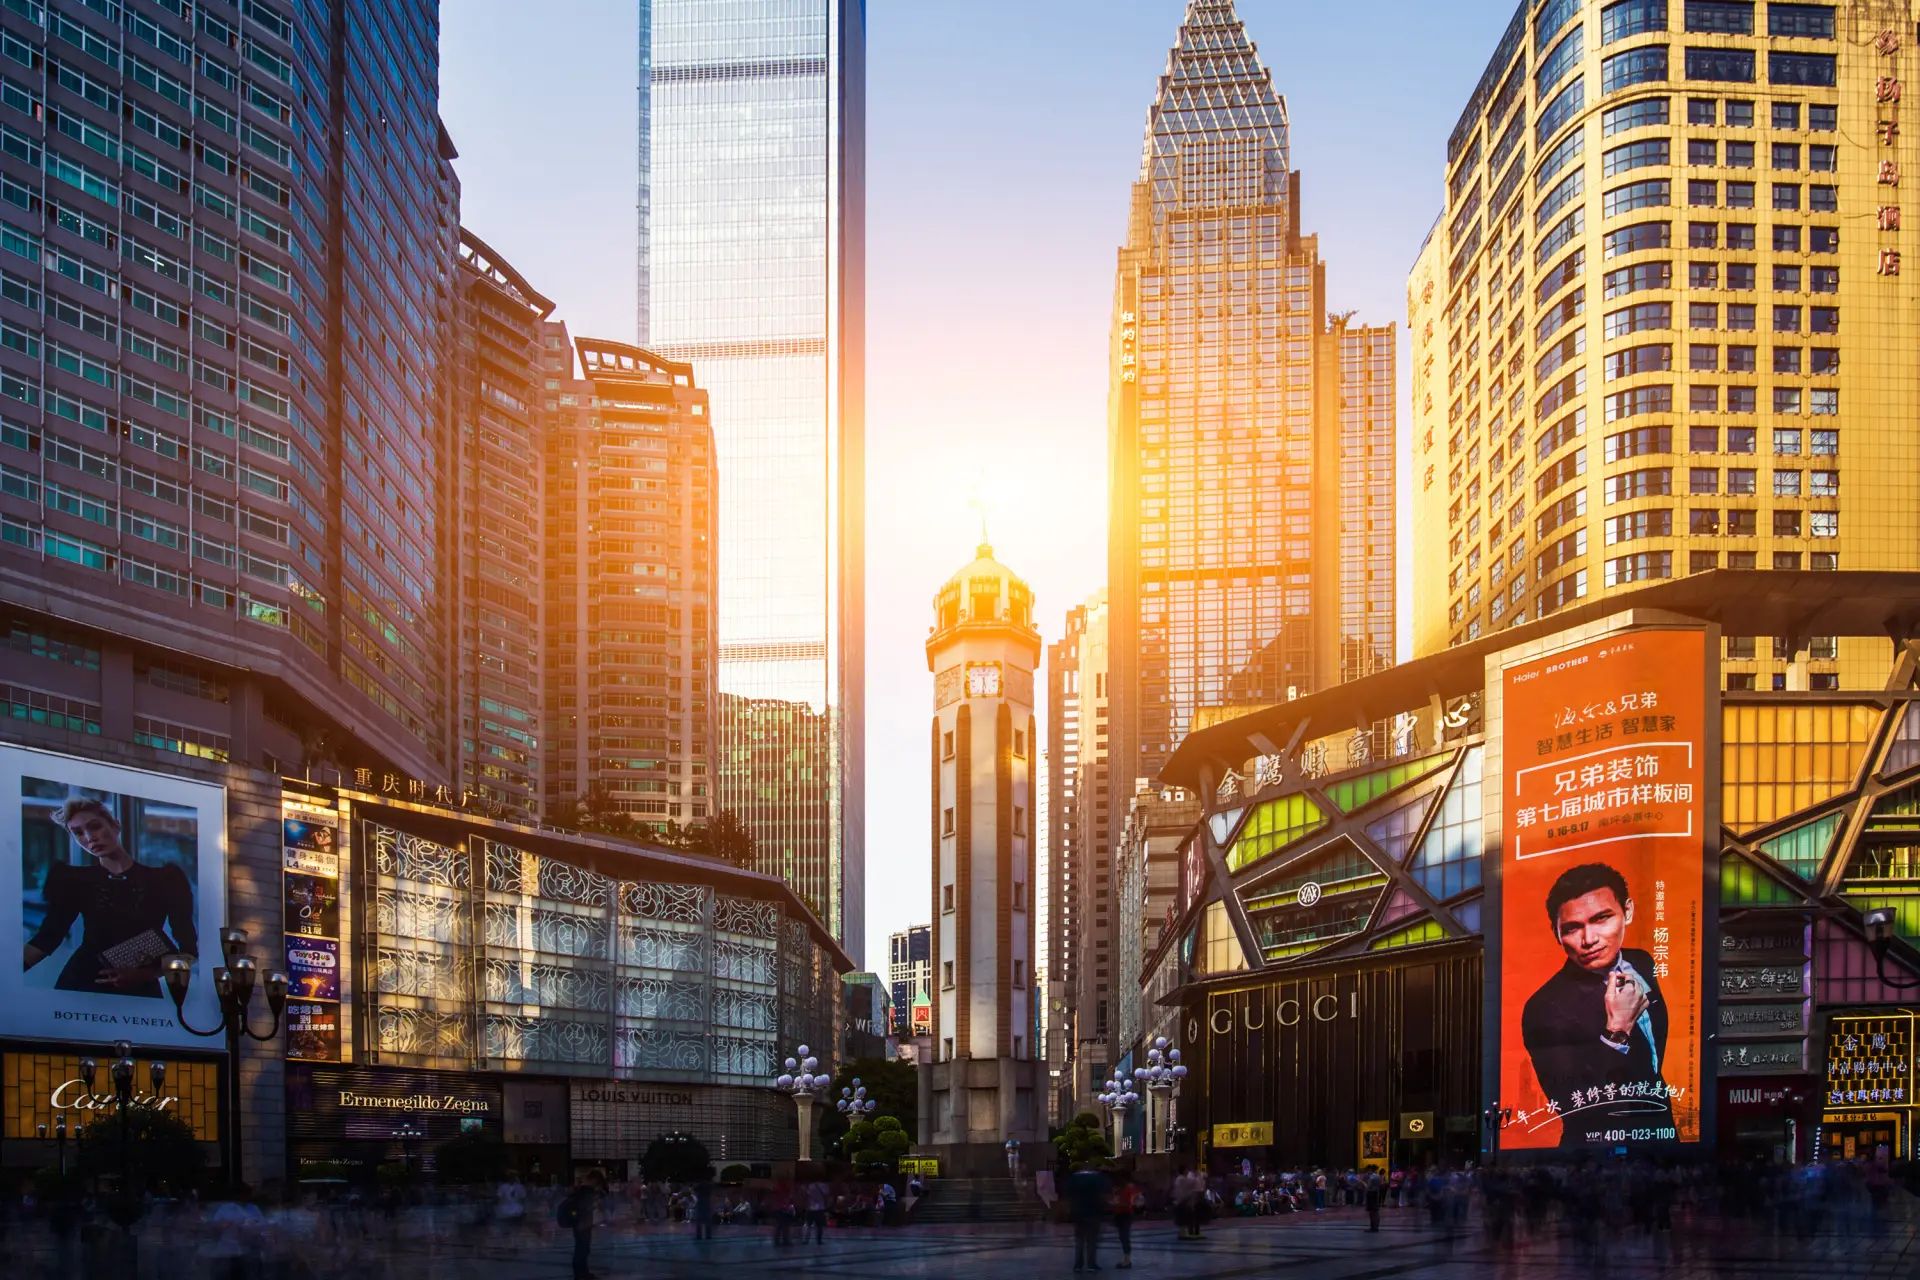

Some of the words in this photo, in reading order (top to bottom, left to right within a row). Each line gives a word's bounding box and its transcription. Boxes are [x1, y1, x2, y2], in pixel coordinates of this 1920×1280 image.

[1876, 76, 1901, 276] 扬子岛酒店
[1513, 670, 1540, 684] Haier
[1546, 655, 1589, 674] BROTHER
[1216, 703, 1471, 797] 金鹰财富中心
[1537, 722, 1613, 756] 智慧生活
[1621, 715, 1676, 736] 智慧家
[1553, 755, 1659, 795] 兄弟装饰
[1516, 783, 1693, 828] 第七届城市样板间
[1547, 821, 1589, 839] 9.16-9.17
[1655, 880, 1665, 922] 特邀嘉宾
[1652, 927, 1669, 978] 杨宗纬
[54, 1010, 118, 1024] BOTTEGA
[122, 1015, 174, 1028] VENETA
[1211, 991, 1359, 1034] GUCCI
[339, 1091, 440, 1111] Ermenegildo
[443, 1096, 489, 1113] Zegna
[581, 1090, 625, 1103] LOUIS
[631, 1092, 693, 1105] VUITTON
[1730, 1088, 1762, 1104] MUJI
[1604, 1128, 1675, 1142] 400-023-1100
